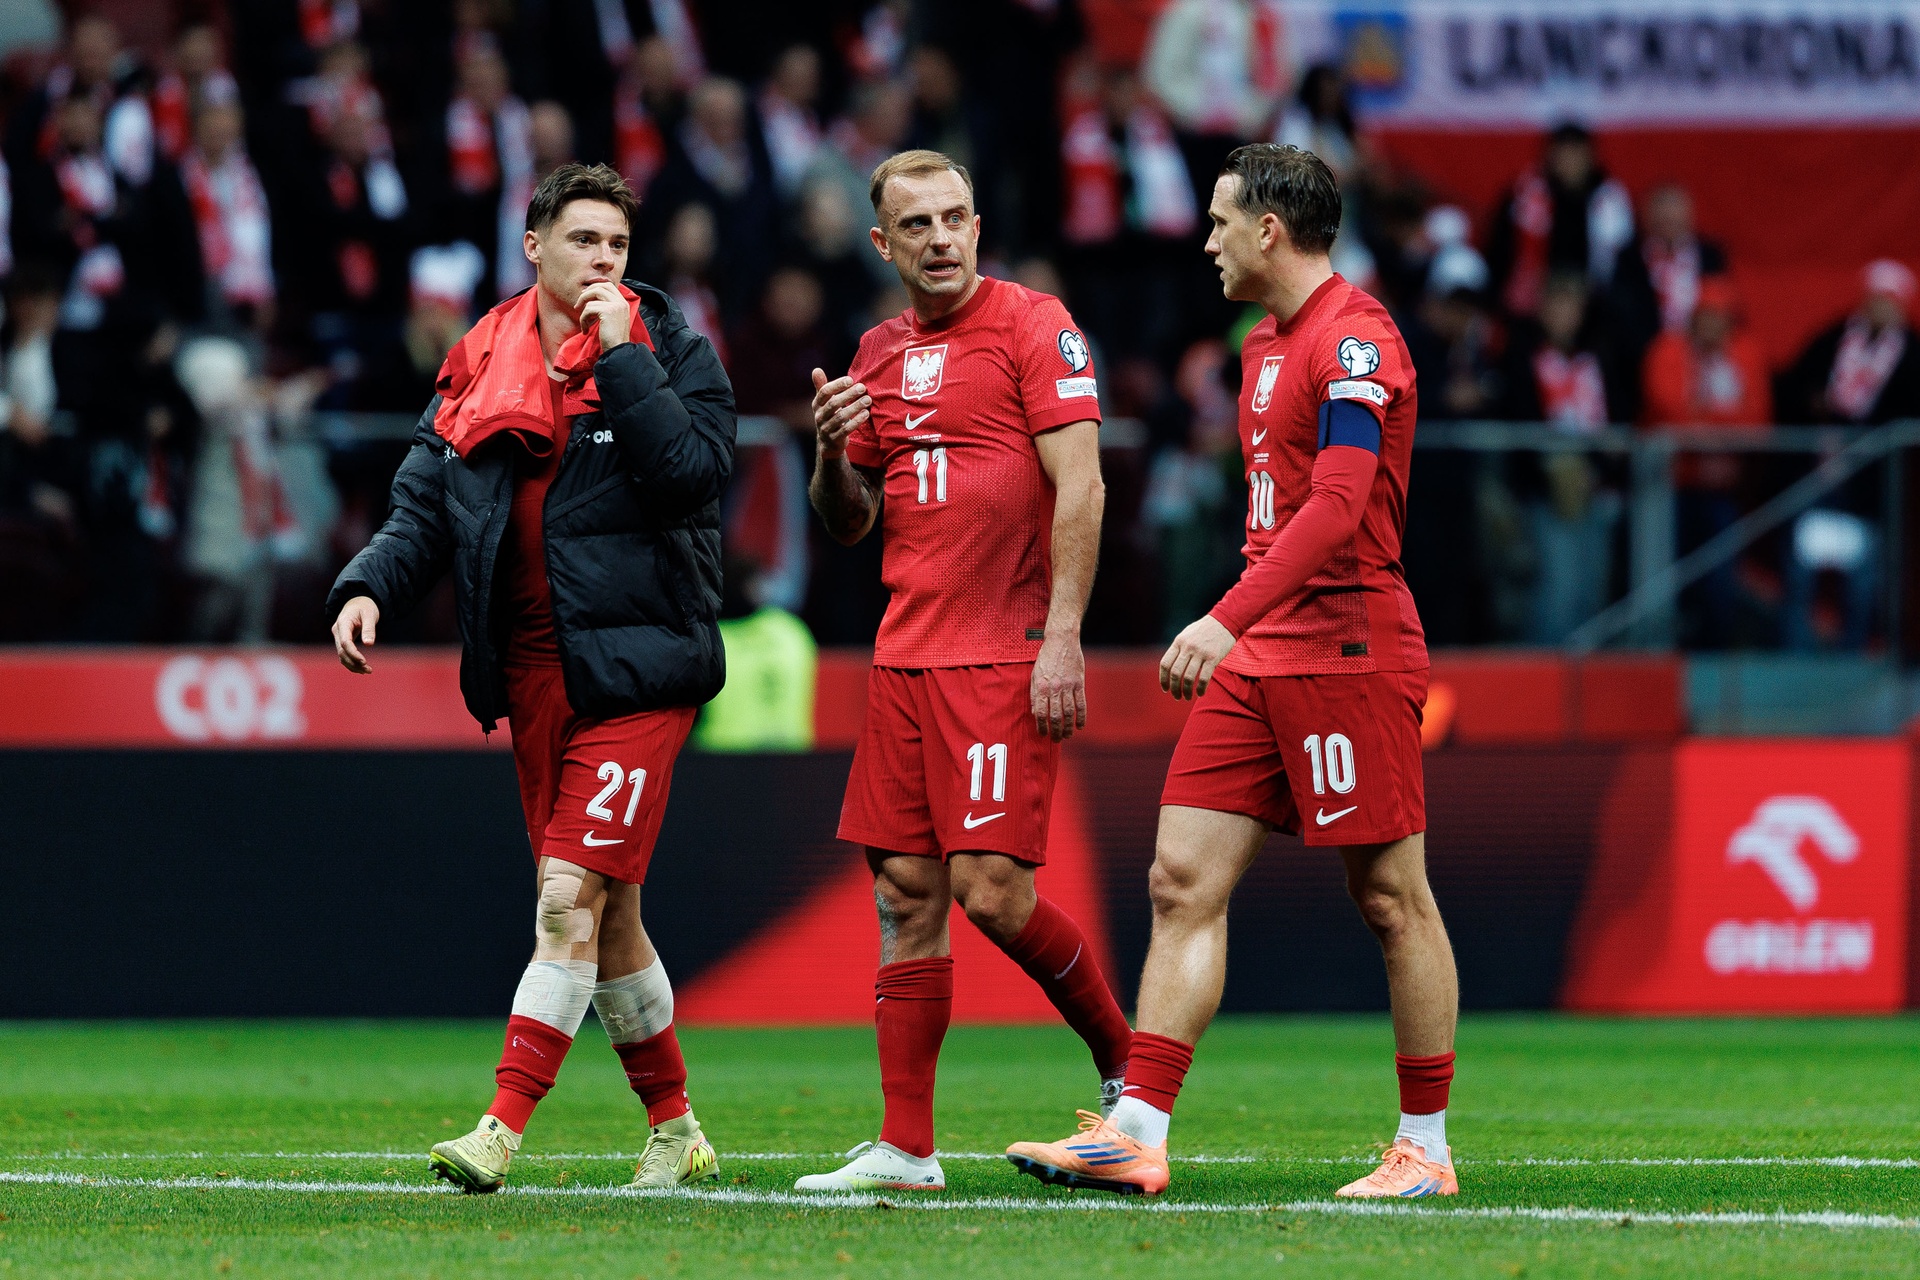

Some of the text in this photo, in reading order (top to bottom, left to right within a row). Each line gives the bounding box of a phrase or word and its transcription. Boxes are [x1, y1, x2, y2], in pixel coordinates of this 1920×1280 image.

[593, 430, 614, 444] OR
[913, 445, 948, 504] 11
[1250, 470, 1275, 530] 10
[967, 742, 1008, 802] 11
[1303, 732, 1356, 795] 10
[586, 761, 647, 827] 21
[1704, 919, 1874, 975] ORLEN
[856, 1172, 903, 1181] FURON
